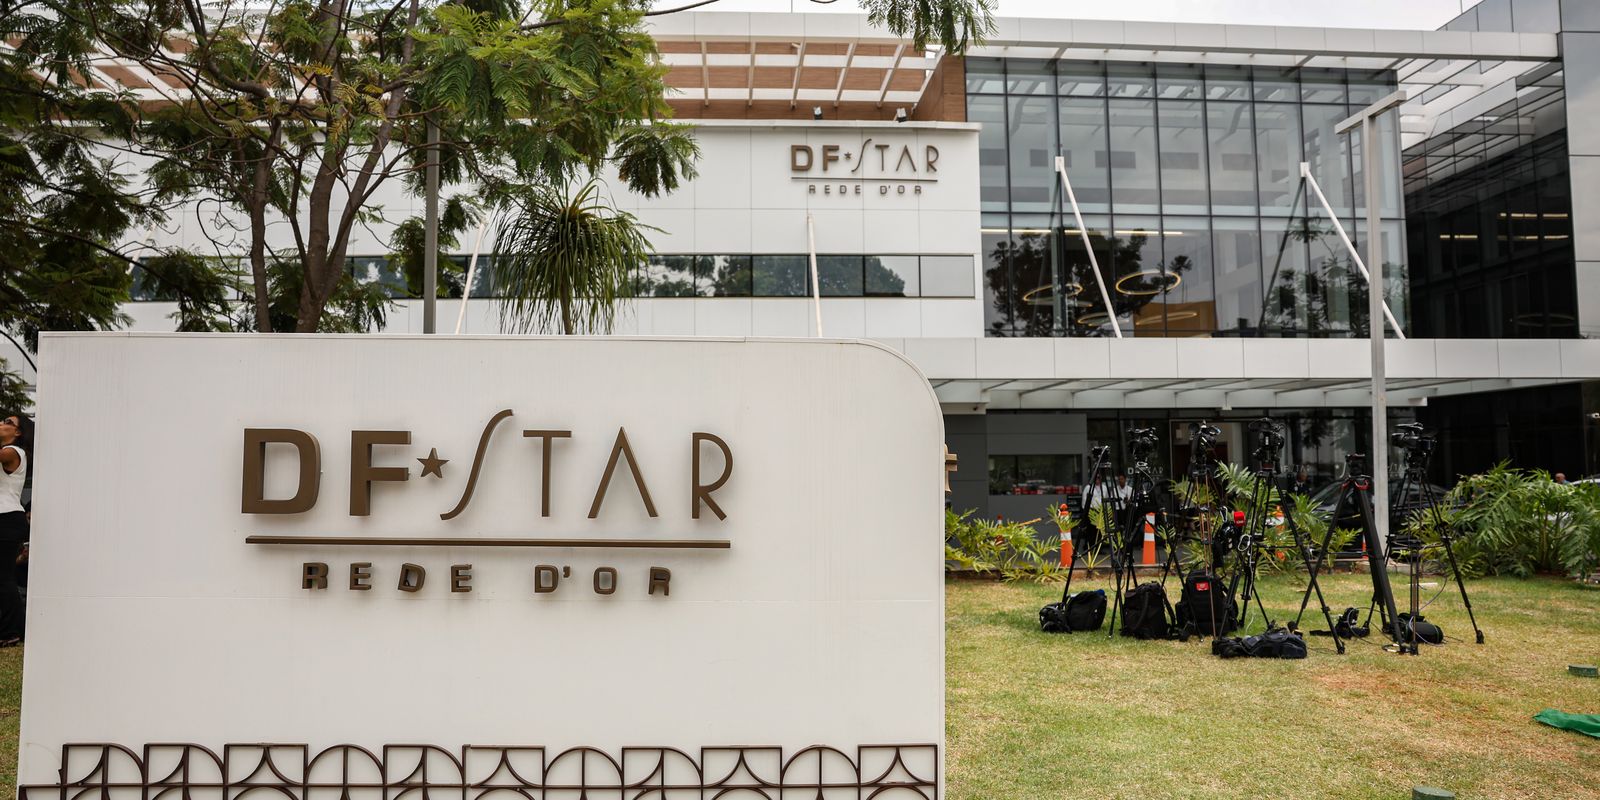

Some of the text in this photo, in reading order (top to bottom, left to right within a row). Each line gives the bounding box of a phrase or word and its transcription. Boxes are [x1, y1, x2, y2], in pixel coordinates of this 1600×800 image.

[791, 138, 940, 173] DF STAR
[808, 185, 922, 195] REDE D'OR
[241, 408, 734, 521] DF STAR
[302, 562, 672, 596] REDE D'OR
